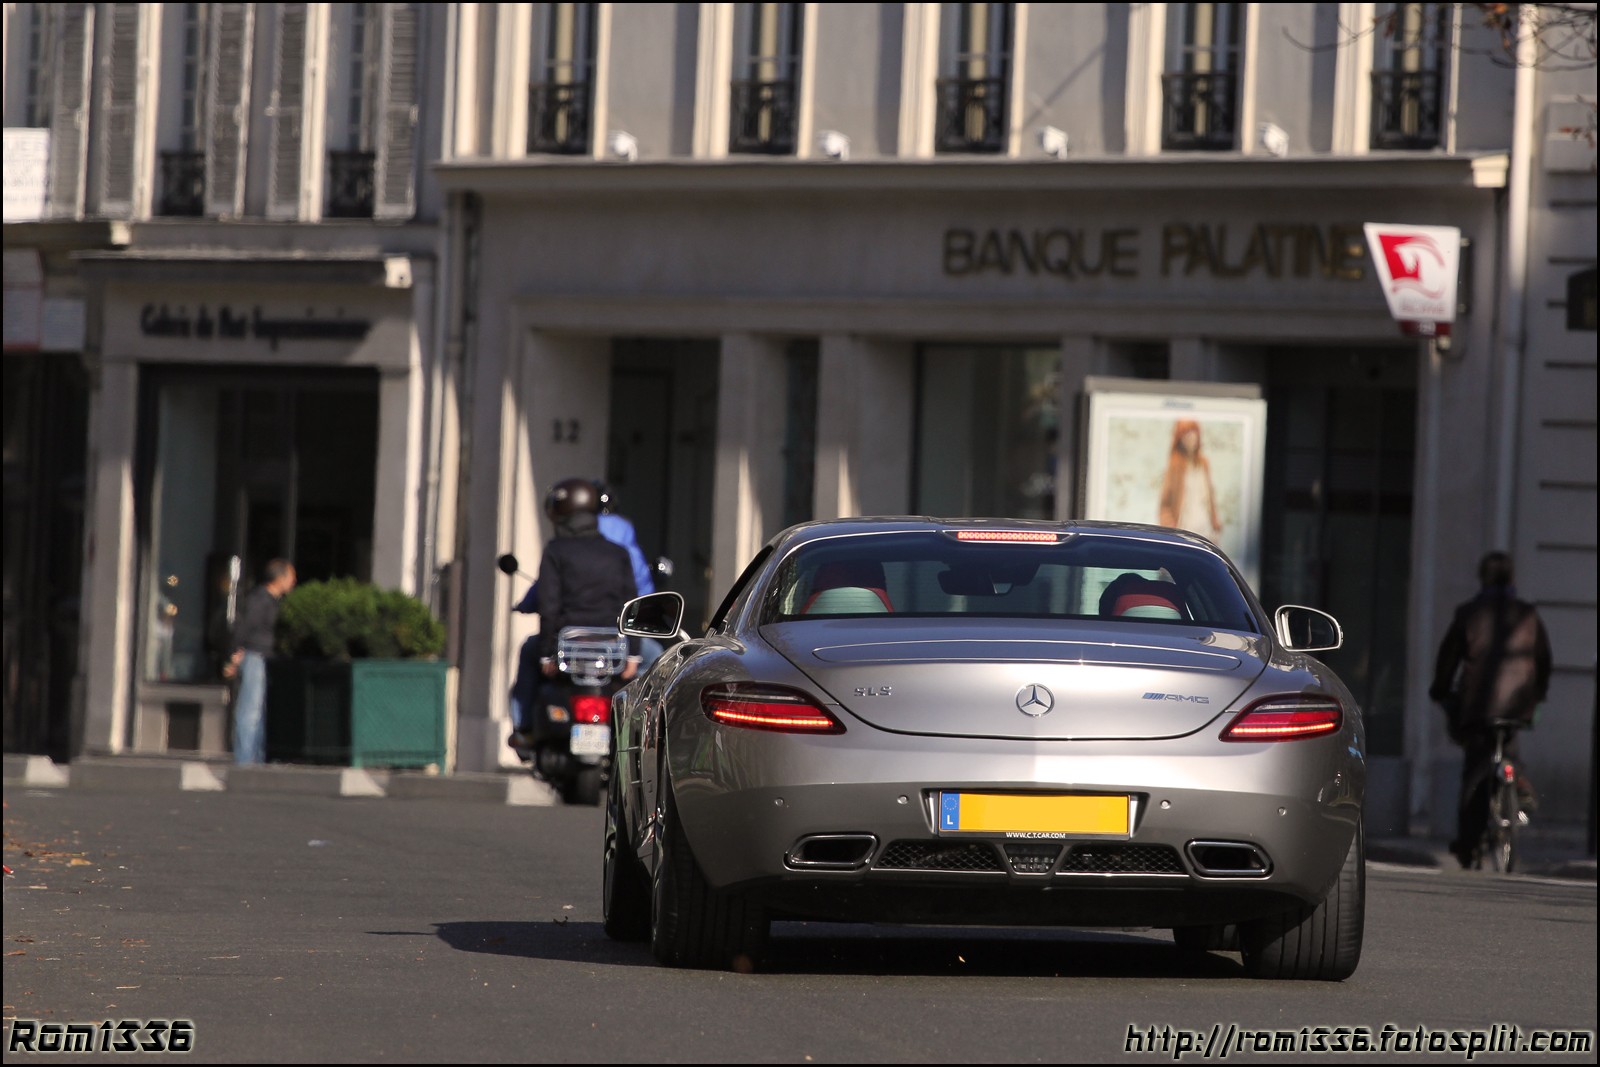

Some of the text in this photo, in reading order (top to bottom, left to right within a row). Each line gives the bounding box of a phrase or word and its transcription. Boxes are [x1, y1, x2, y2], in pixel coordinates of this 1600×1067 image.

[943, 222, 1365, 280] BANQUE PALATINE
[551, 418, 580, 444] 12
[853, 686, 892, 697] SLS
[1164, 693, 1210, 705] AMG
[946, 814, 954, 825] L
